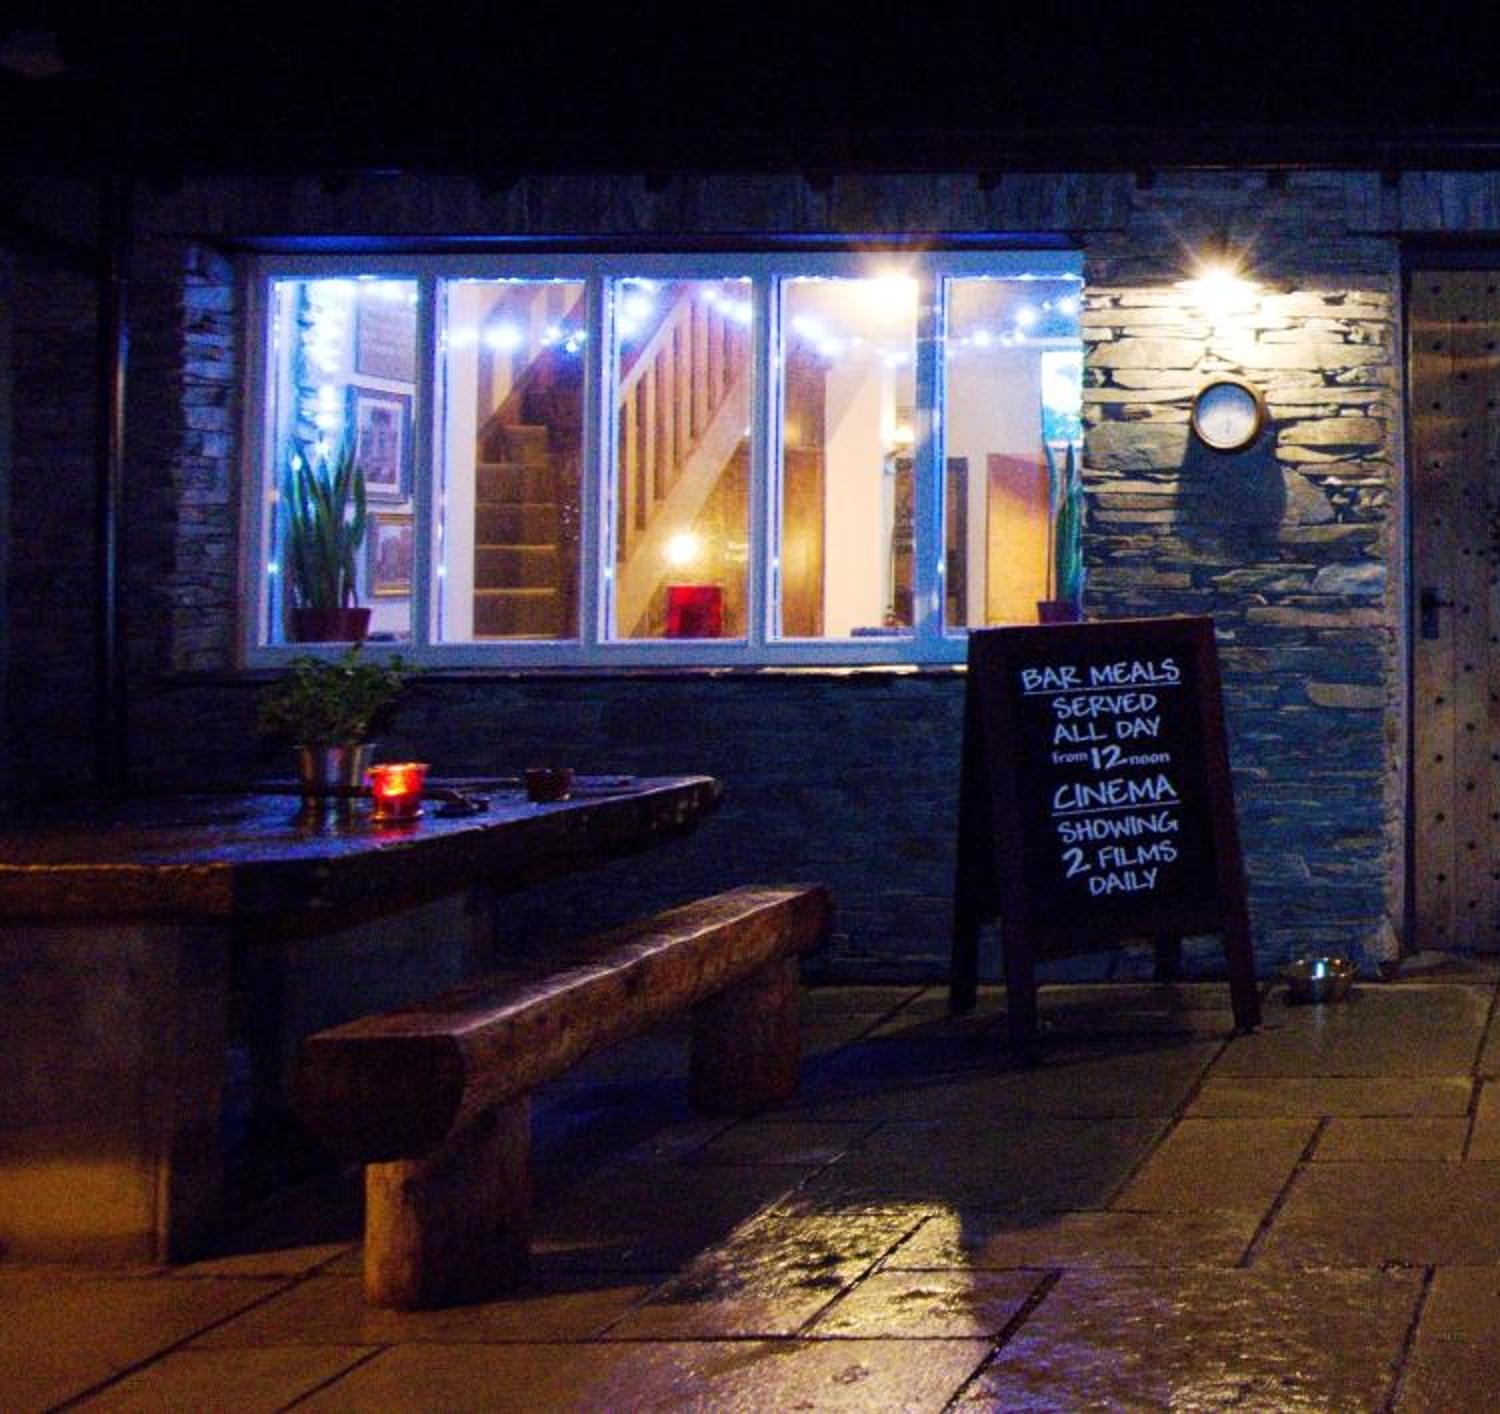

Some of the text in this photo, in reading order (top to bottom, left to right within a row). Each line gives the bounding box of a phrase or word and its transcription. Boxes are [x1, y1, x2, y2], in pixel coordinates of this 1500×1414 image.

[1021, 658, 1180, 690] BAR MEALS
[1052, 693, 1157, 719] SERVED
[1053, 716, 1161, 744] ALL DAY
[1052, 745, 1170, 769] from 12 noon
[1054, 774, 1178, 808] CINEMA
[1058, 811, 1179, 842] SHOWING
[1061, 840, 1178, 878] 2 FILMS
[1088, 868, 1158, 896] DAILY
